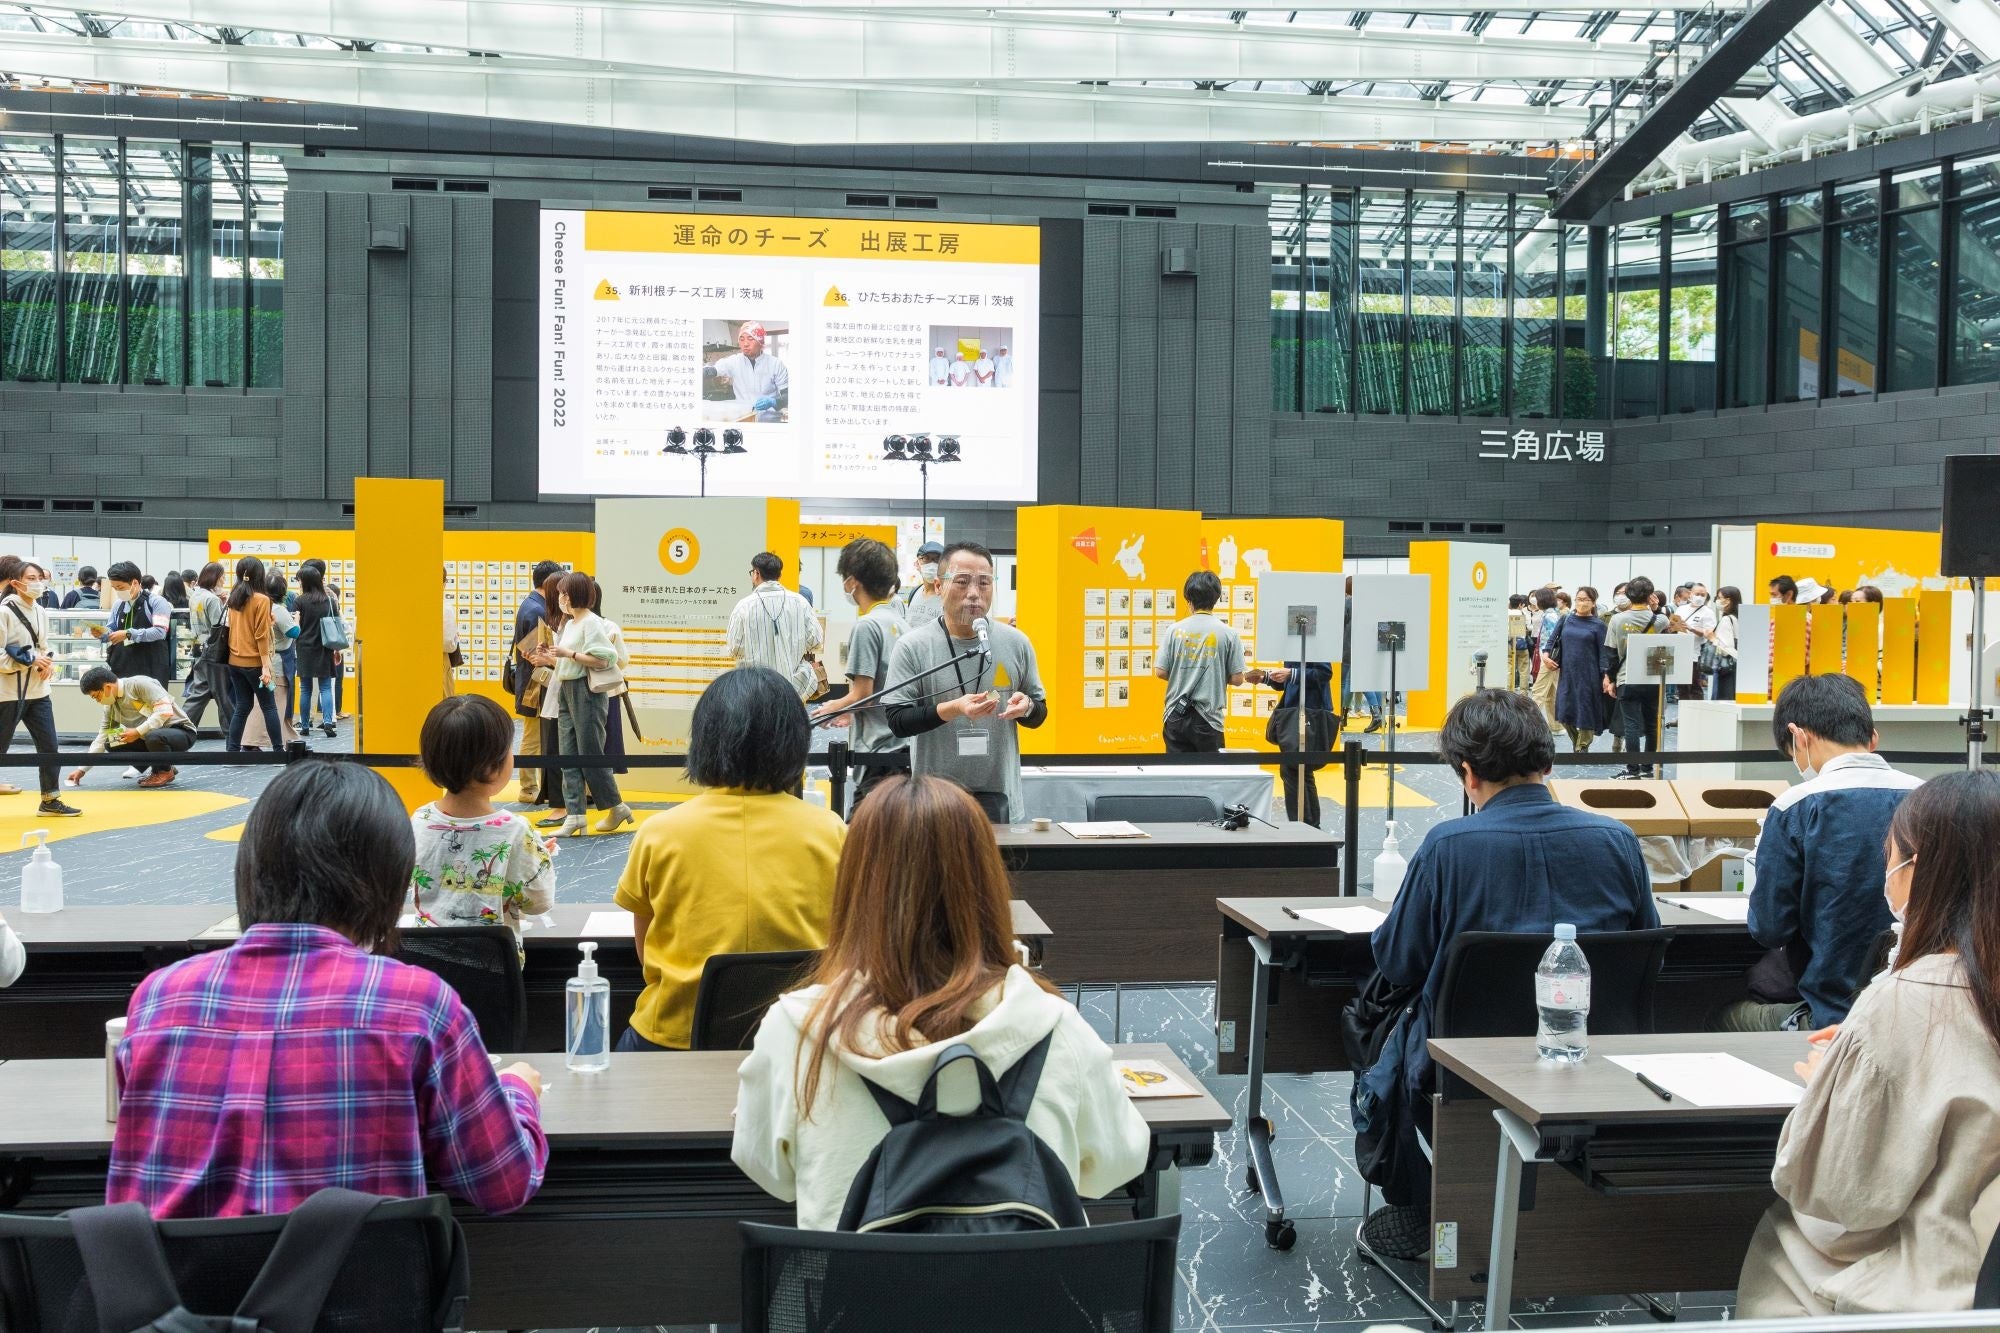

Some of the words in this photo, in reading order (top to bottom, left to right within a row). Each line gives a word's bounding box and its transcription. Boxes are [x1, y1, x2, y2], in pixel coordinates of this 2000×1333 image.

[554, 221, 566, 274] Cheese
[673, 224, 830, 248] 運命のチーズ
[860, 230, 960, 254] 出展工房
[554, 279, 566, 310] Fun!
[605, 286, 622, 295] 35.
[834, 292, 851, 302] 36.
[554, 315, 566, 345] Fan!
[554, 350, 566, 381] Fun!
[553, 388, 566, 428] 2022
[1478, 429, 1606, 462] 三角広場
[239, 543, 263, 552] チーズ
[675, 545, 684, 558] 5
[622, 585, 737, 595] 海外で評価された日本のチーズたち
